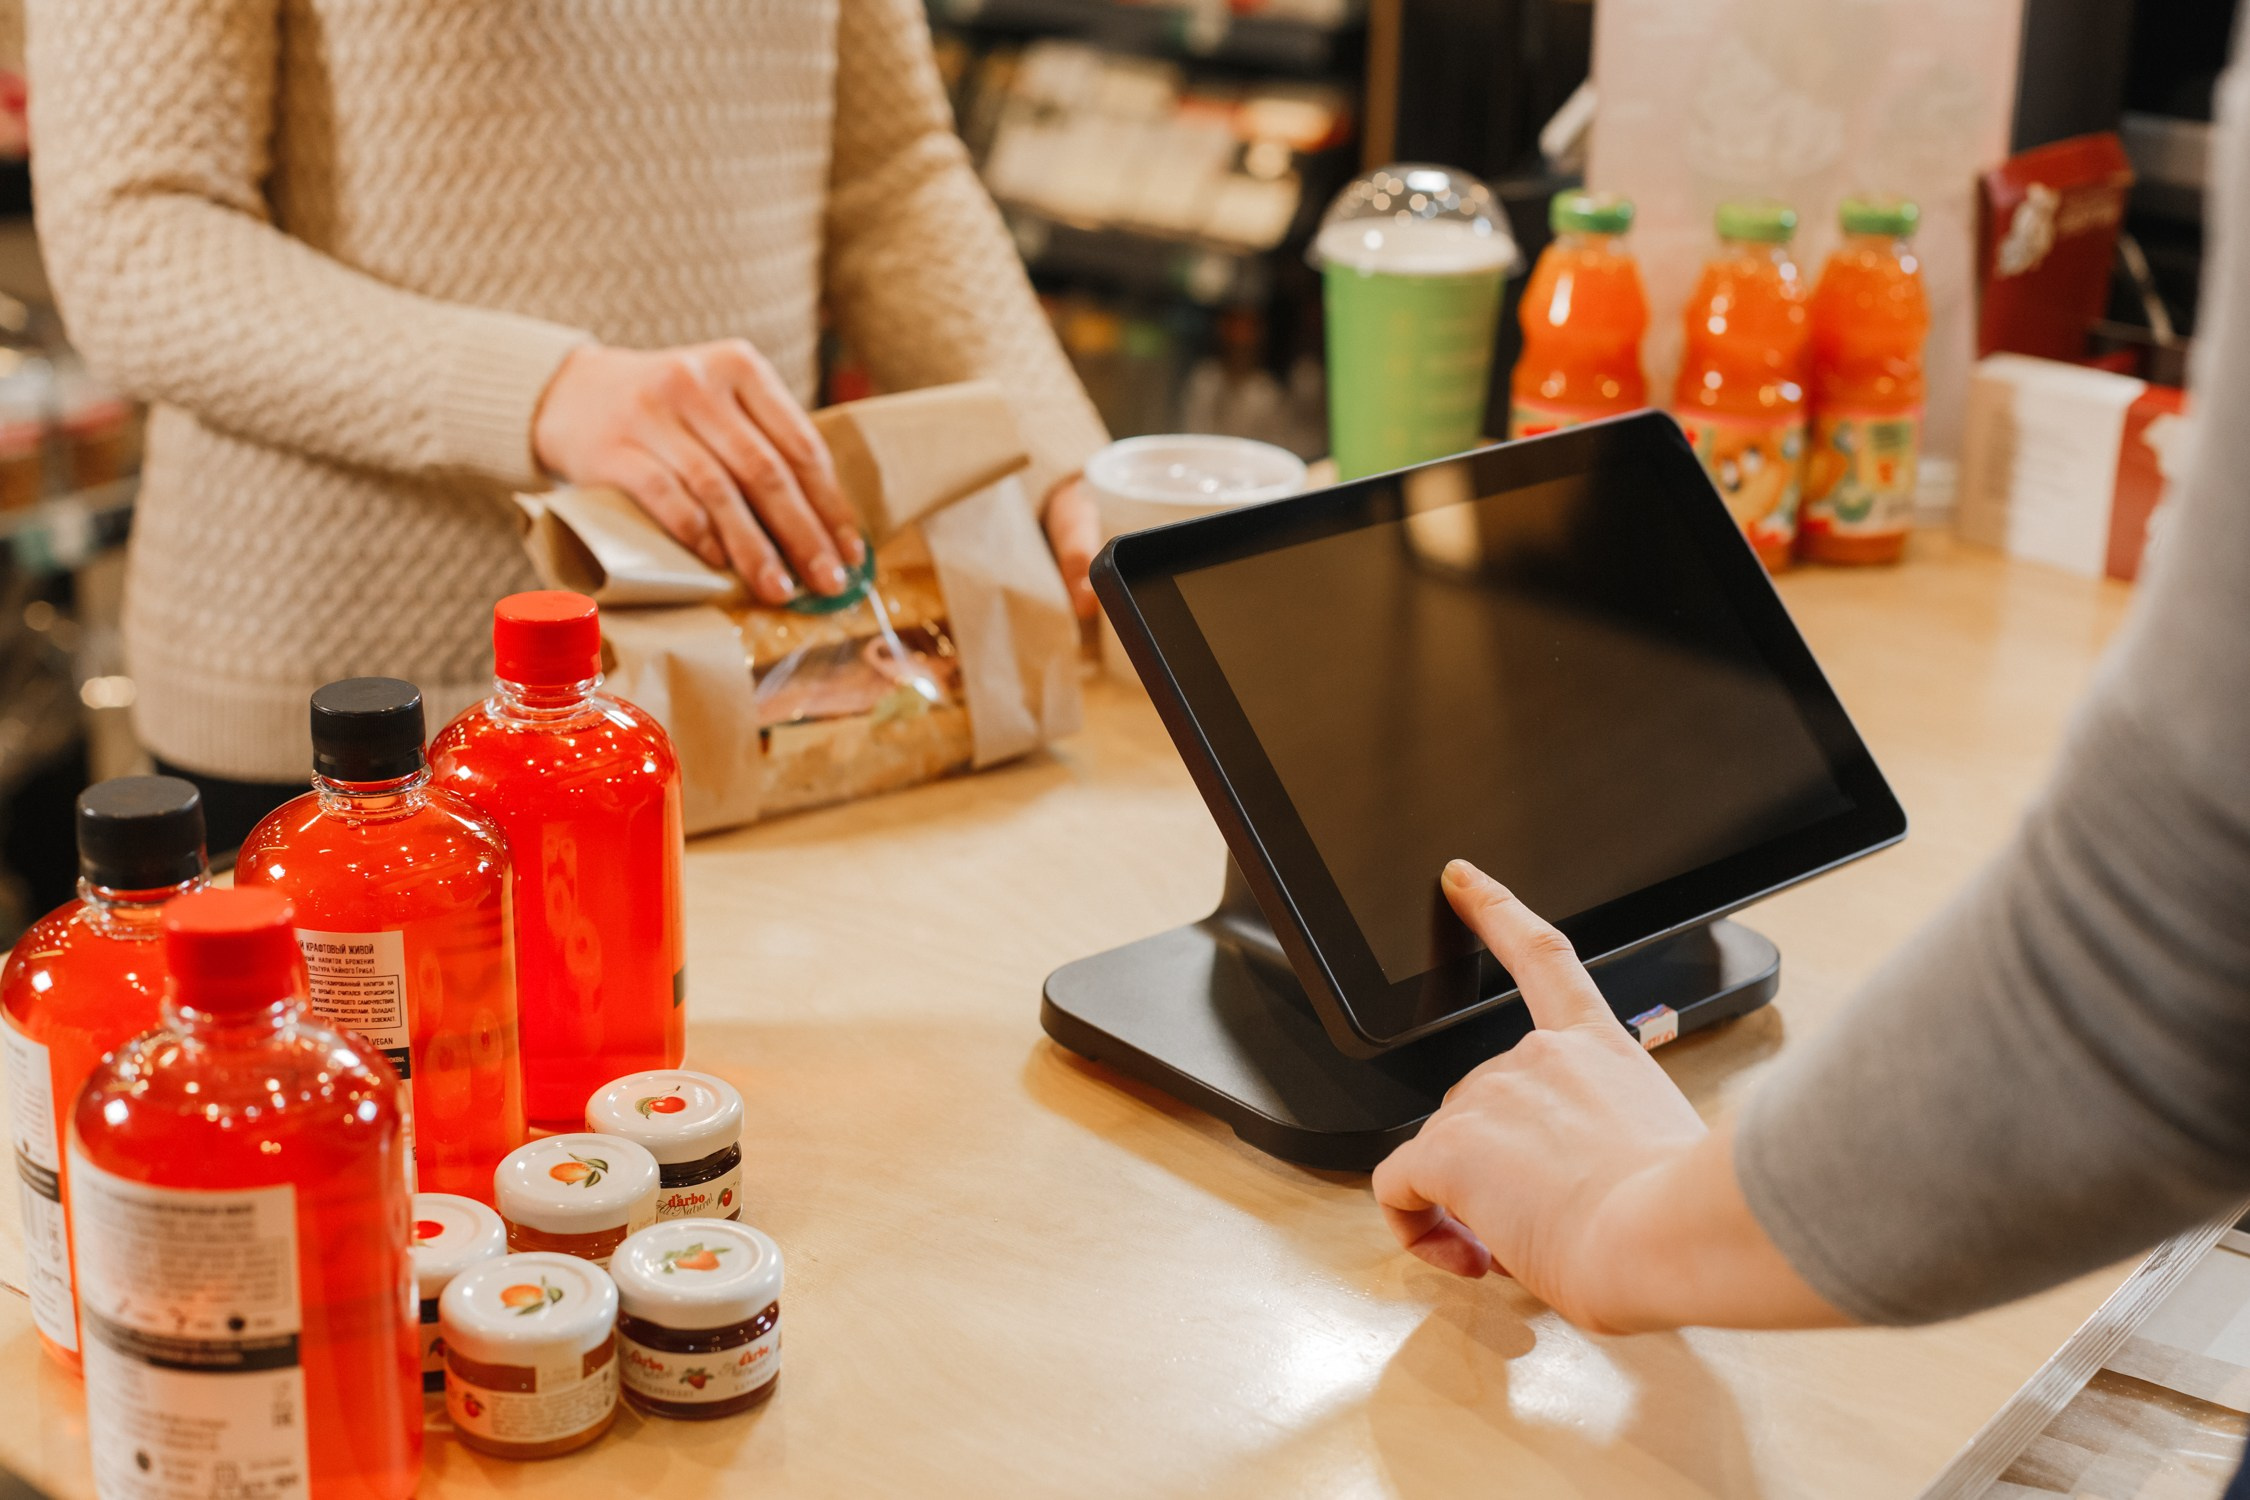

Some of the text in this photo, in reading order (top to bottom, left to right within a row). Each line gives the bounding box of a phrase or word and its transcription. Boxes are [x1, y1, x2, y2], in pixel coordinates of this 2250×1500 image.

[306, 942, 346, 954] КРАФТОВЫЙ
[348, 944, 374, 955] ЖИВОЙ
[318, 957, 342, 965] НАПИТОК
[371, 1038, 393, 1046] VEGAN
